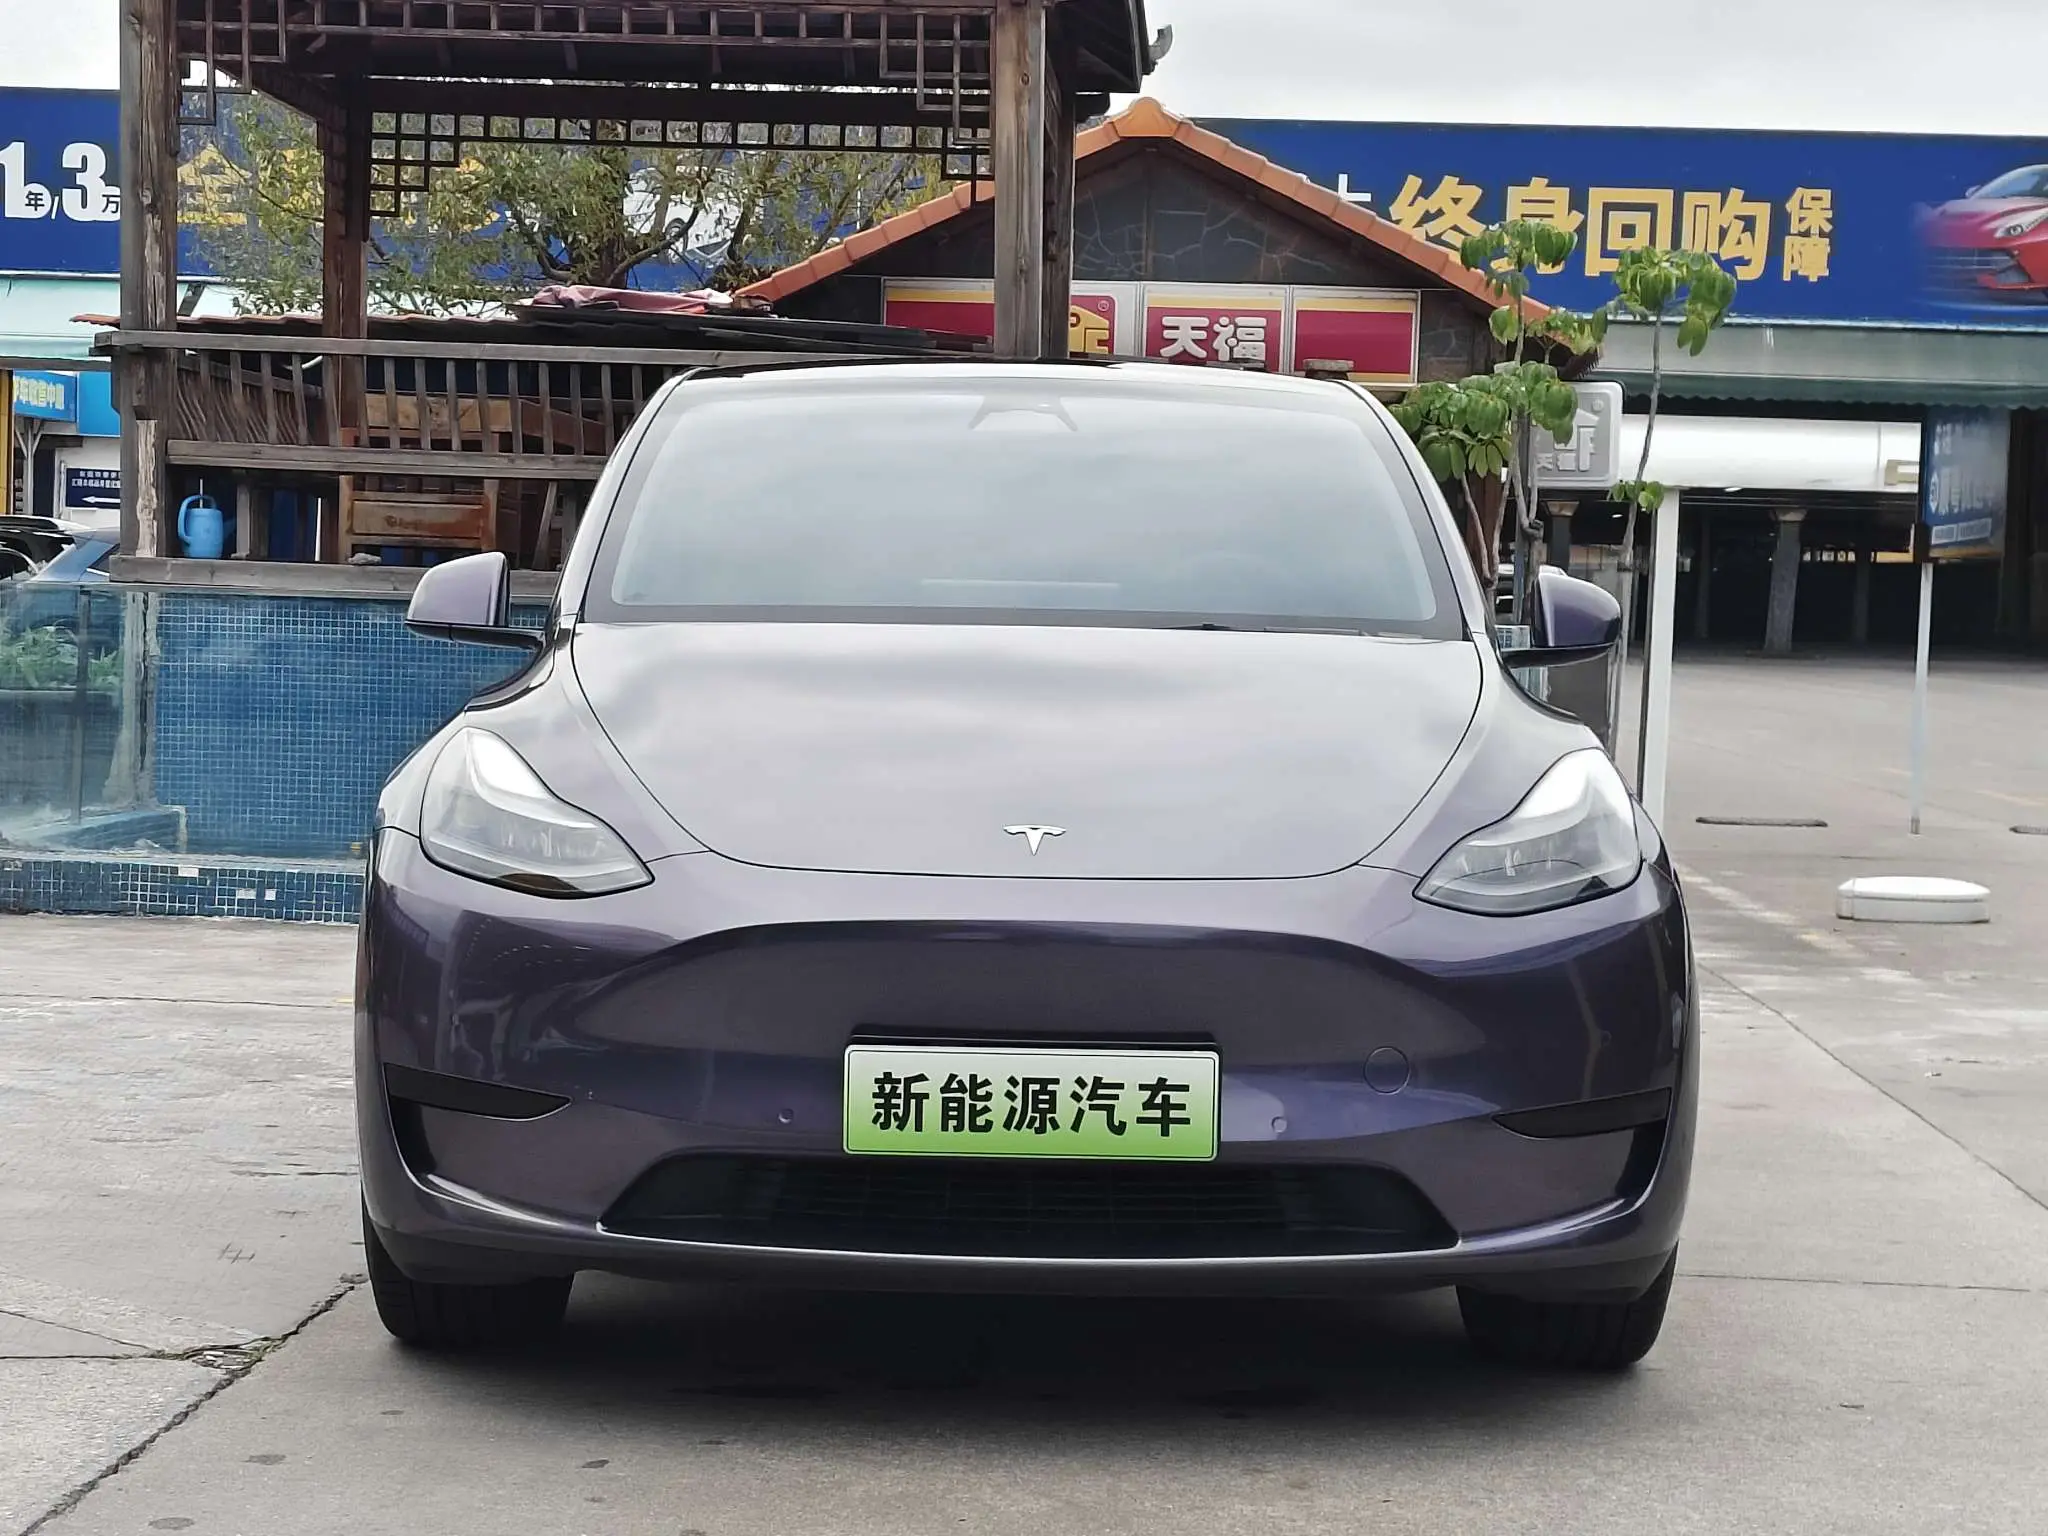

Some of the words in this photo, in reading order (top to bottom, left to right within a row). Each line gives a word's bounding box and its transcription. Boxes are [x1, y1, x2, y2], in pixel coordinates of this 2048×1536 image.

[1782, 186, 1834, 283] 保障
[1161, 316, 1267, 362] 天福
[871, 1071, 1191, 1138] 新能源汽车
